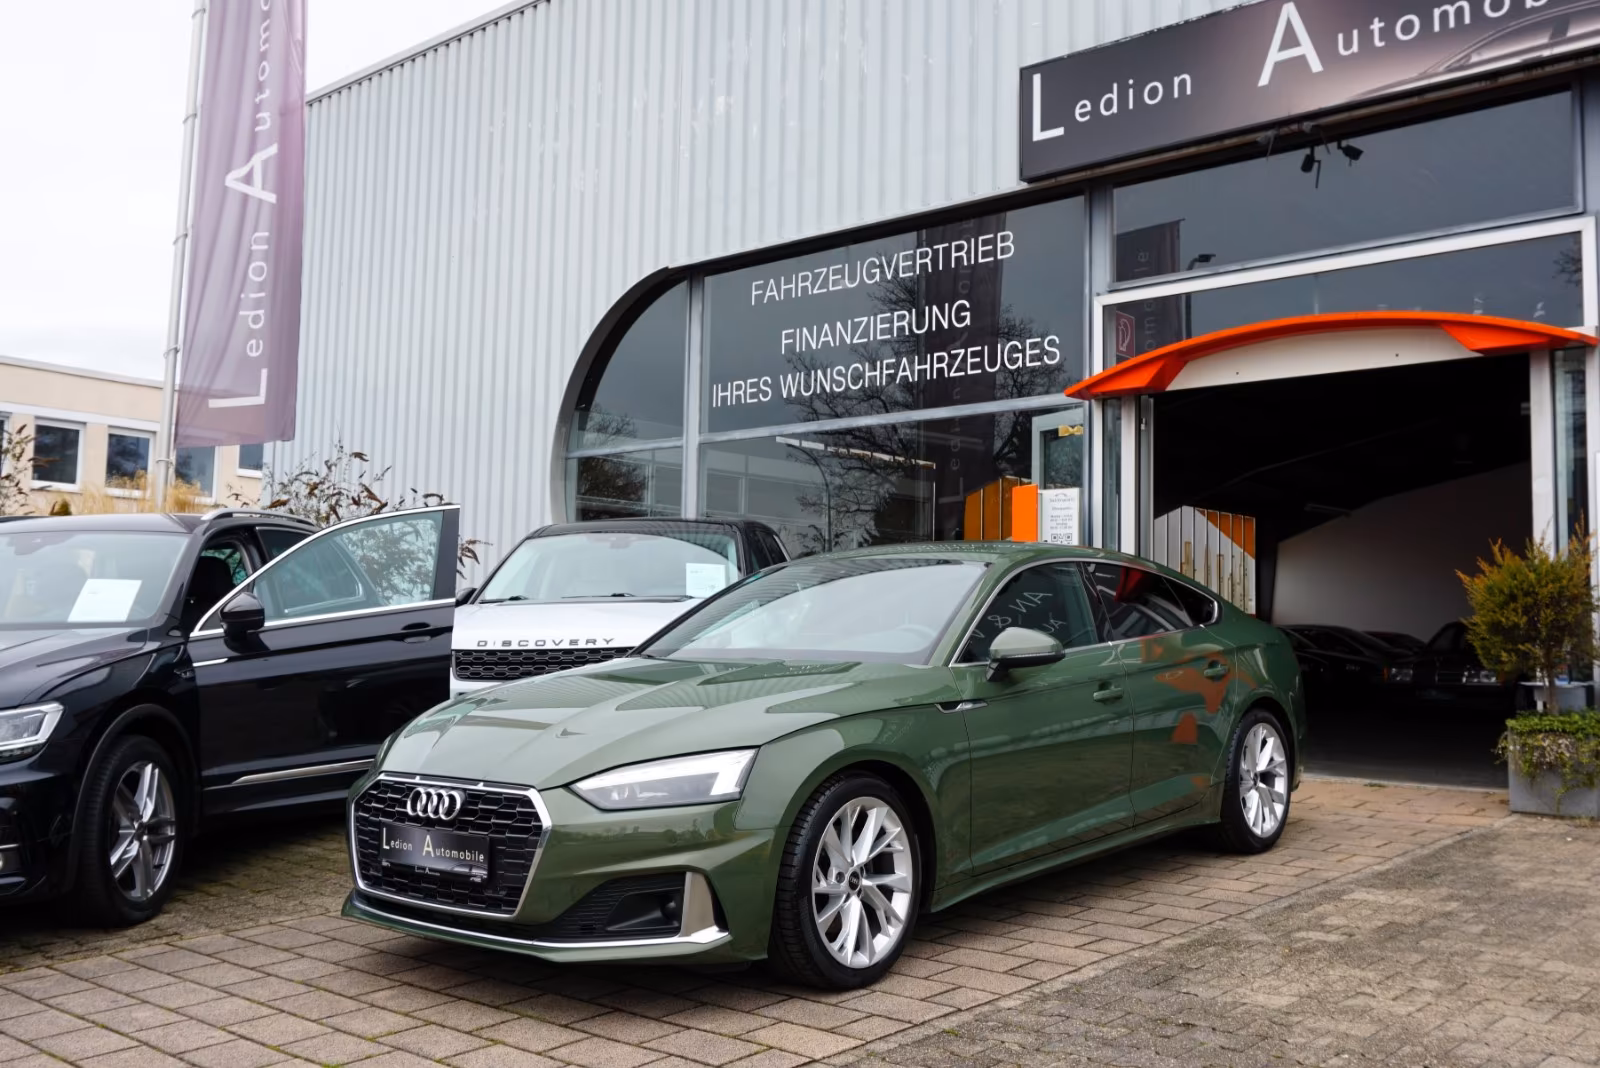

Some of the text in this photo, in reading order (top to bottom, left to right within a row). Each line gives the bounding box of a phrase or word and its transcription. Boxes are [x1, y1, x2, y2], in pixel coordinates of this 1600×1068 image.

[1032, 0, 1554, 141] Ledion Automo
[750, 230, 1016, 306] FAHRZEUGVERTRIEB
[208, 230, 272, 409] Ledion
[781, 299, 971, 355] FINANZIERUNG
[712, 335, 1061, 408] IHRES WUNSCHFAHRZEUGES
[477, 638, 614, 647] DISCOVERY
[382, 827, 485, 862] Ledion Automobile
